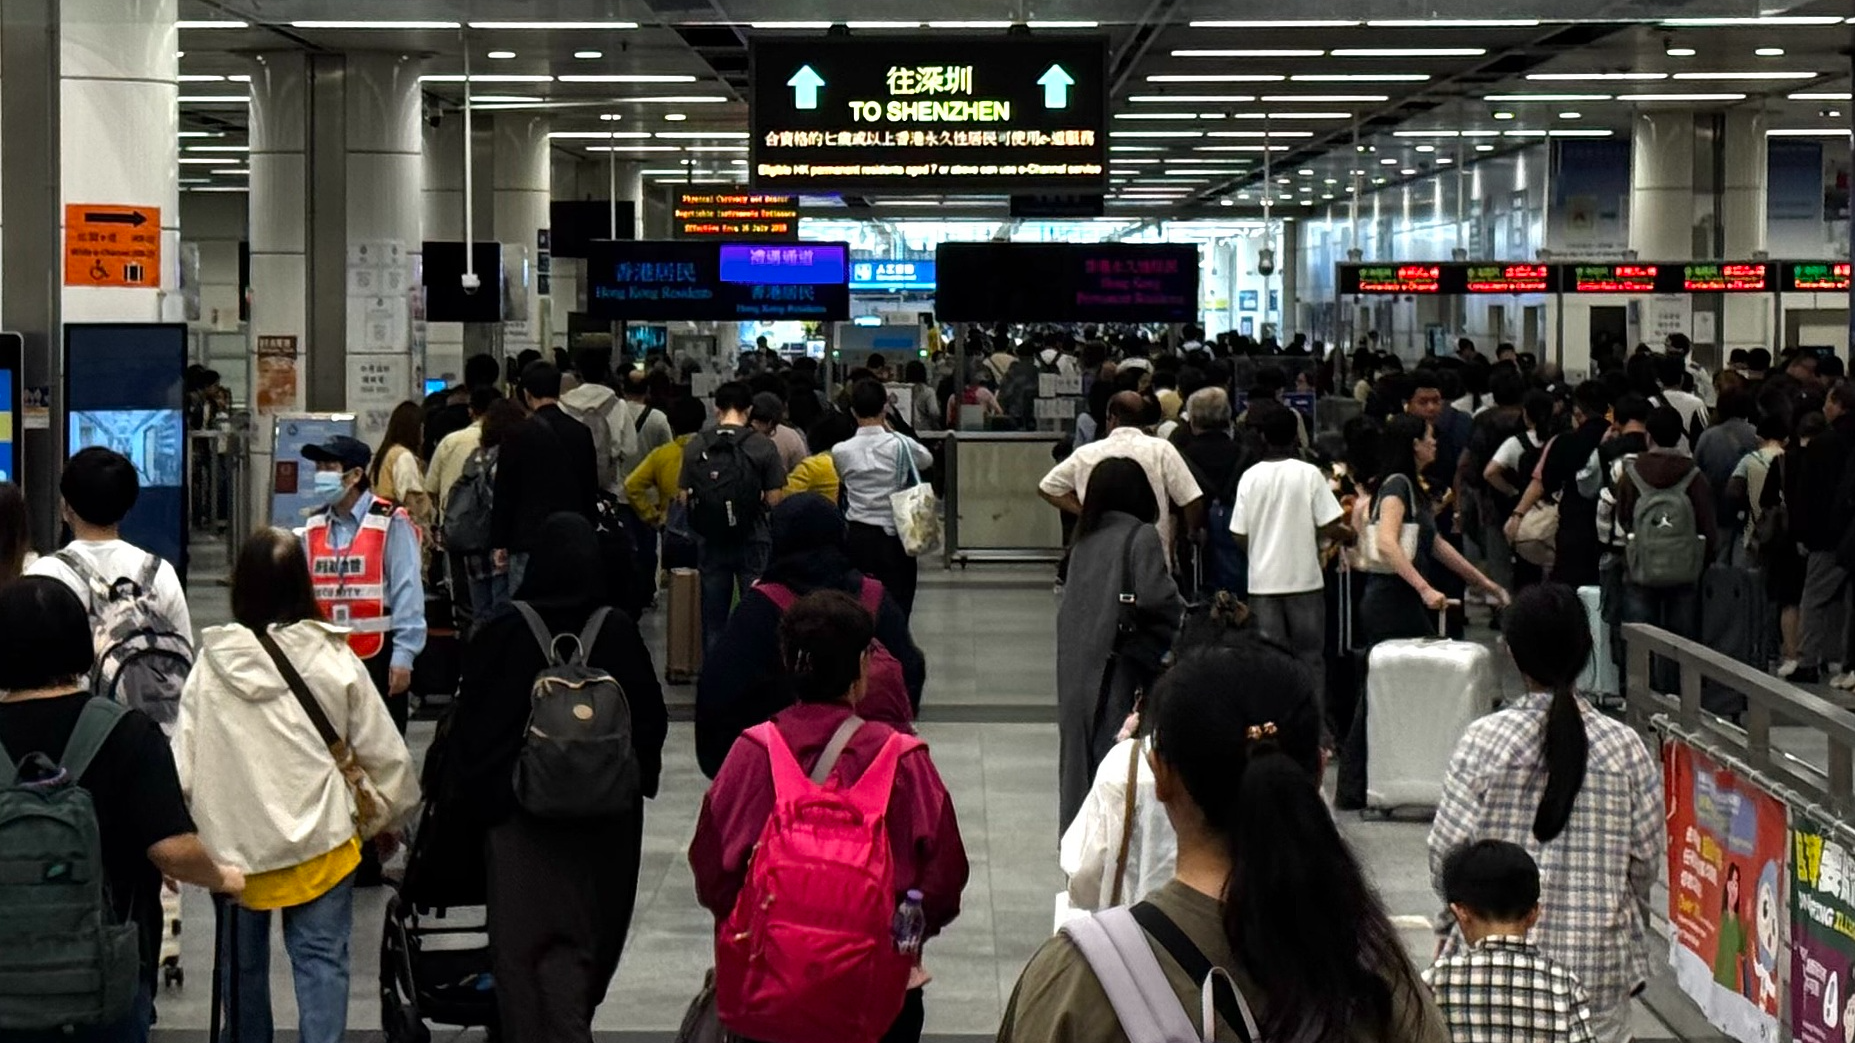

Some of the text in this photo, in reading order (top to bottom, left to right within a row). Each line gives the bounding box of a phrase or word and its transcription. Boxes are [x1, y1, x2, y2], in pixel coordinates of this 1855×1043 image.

[887, 66, 973, 96] 往深圳
[849, 101, 1011, 122] TO SHENZHEN
[793, 165, 809, 175] HK
[616, 261, 696, 282] 香港居民
[595, 285, 626, 300] Hong
[629, 285, 658, 300] Kong
